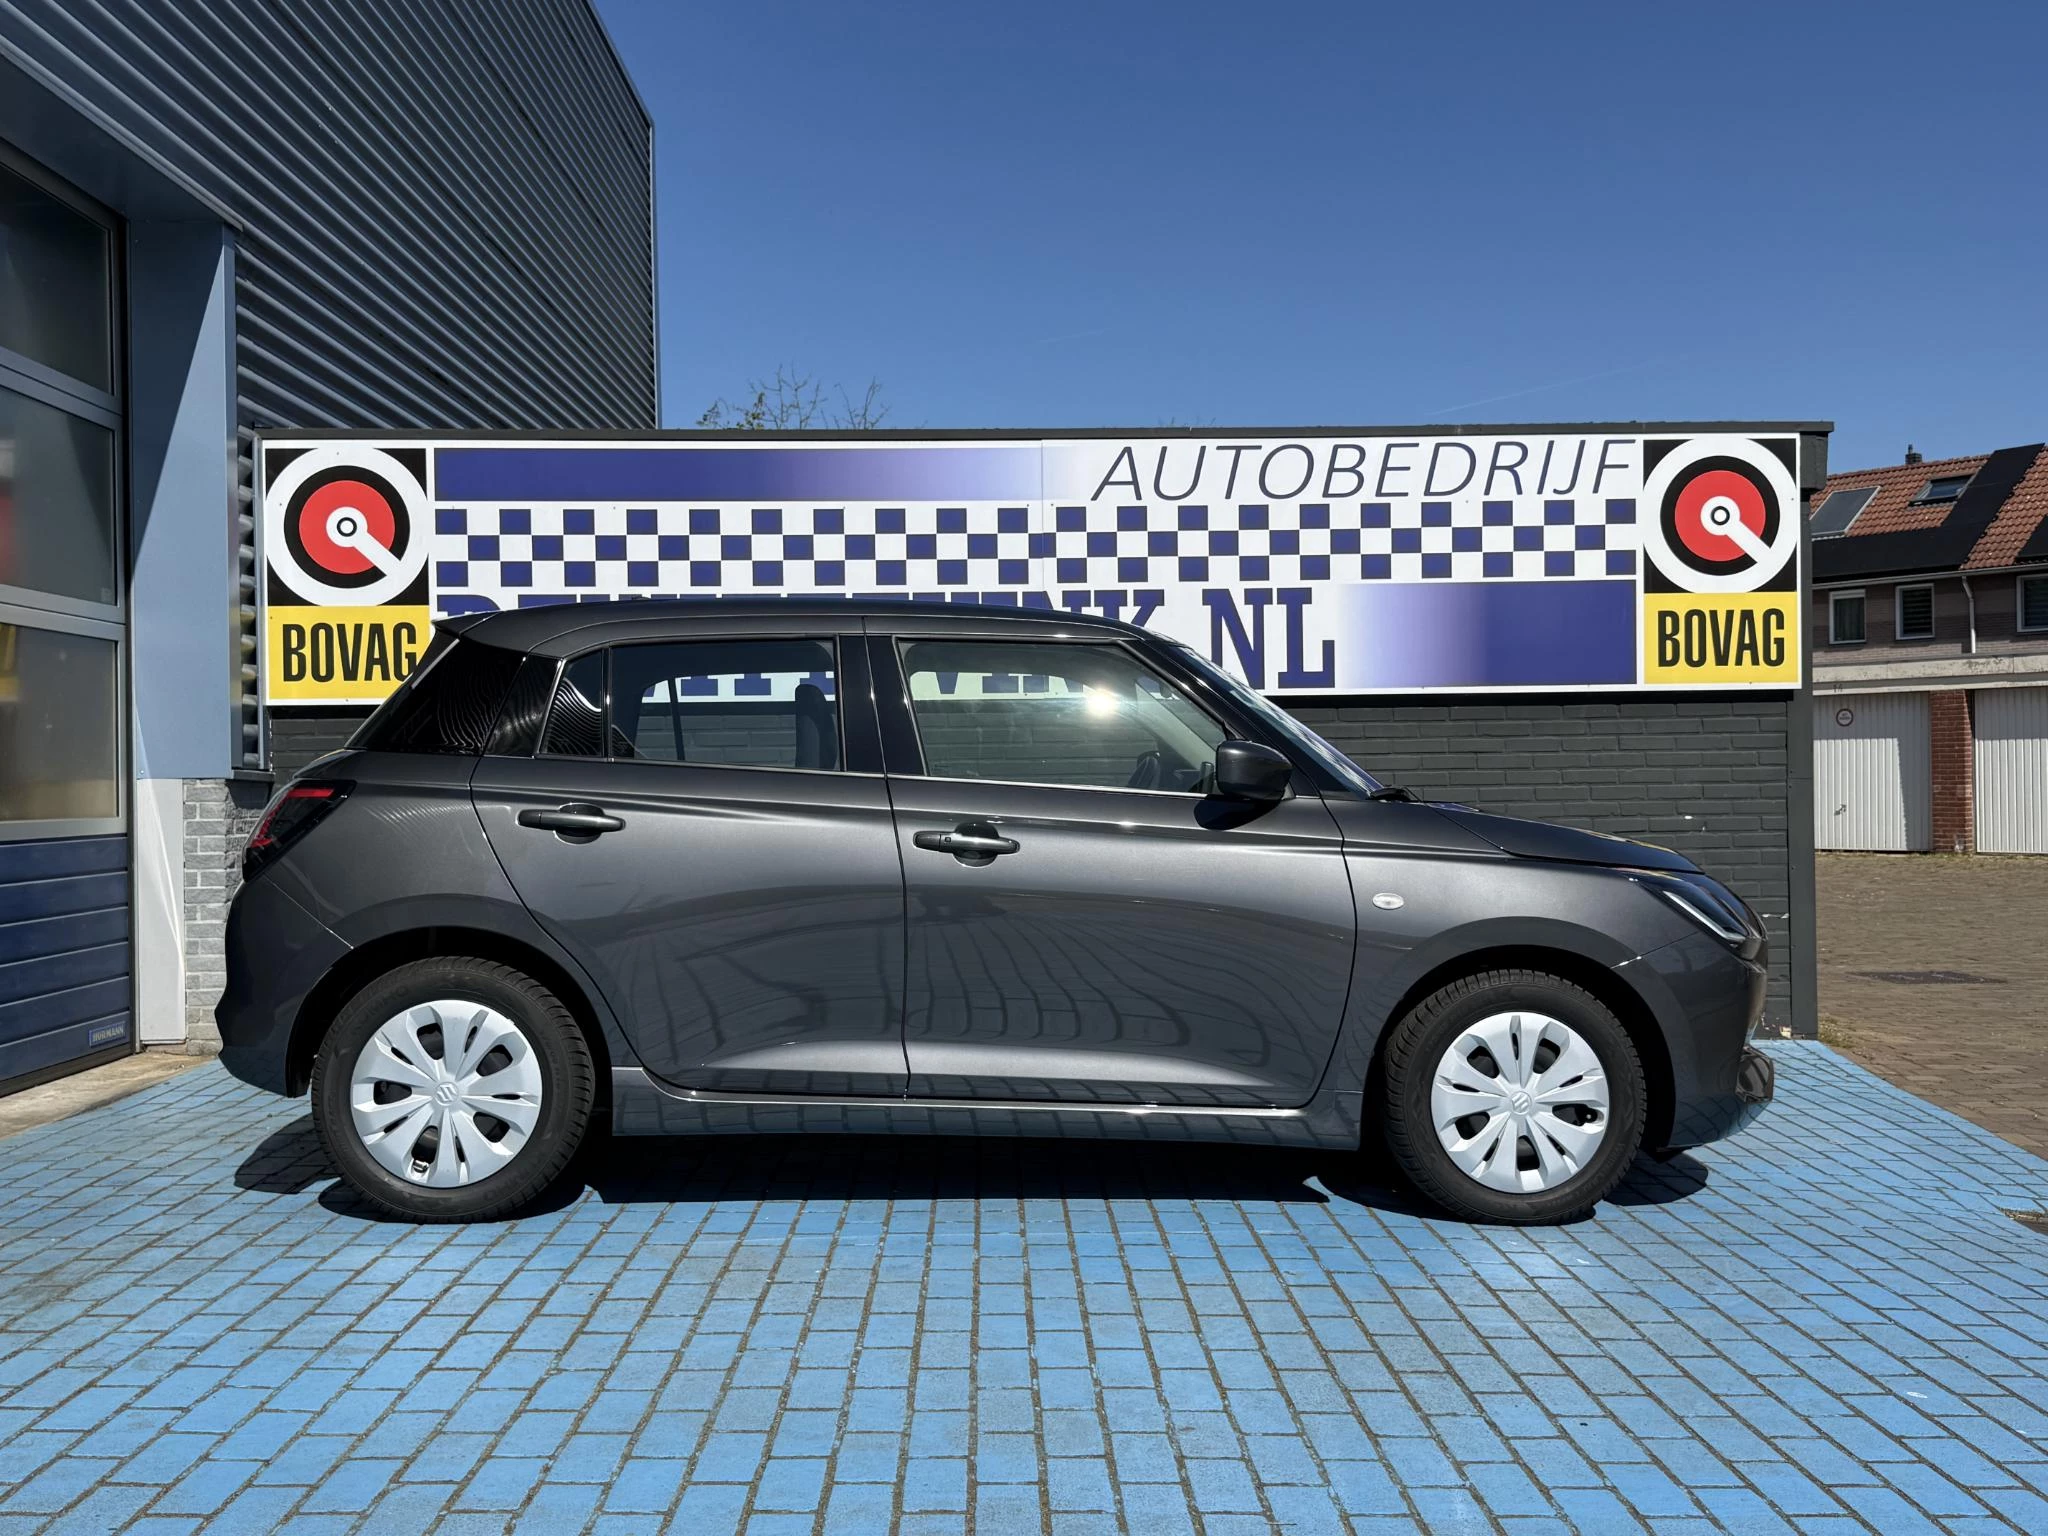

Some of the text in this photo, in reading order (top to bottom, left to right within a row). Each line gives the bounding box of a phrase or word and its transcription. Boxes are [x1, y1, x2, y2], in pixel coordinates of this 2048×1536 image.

[1091, 440, 1636, 501] AUTOBEDRIJF
[283, 622, 417, 683] BOVAG
[1657, 609, 1785, 668] BOVAG
